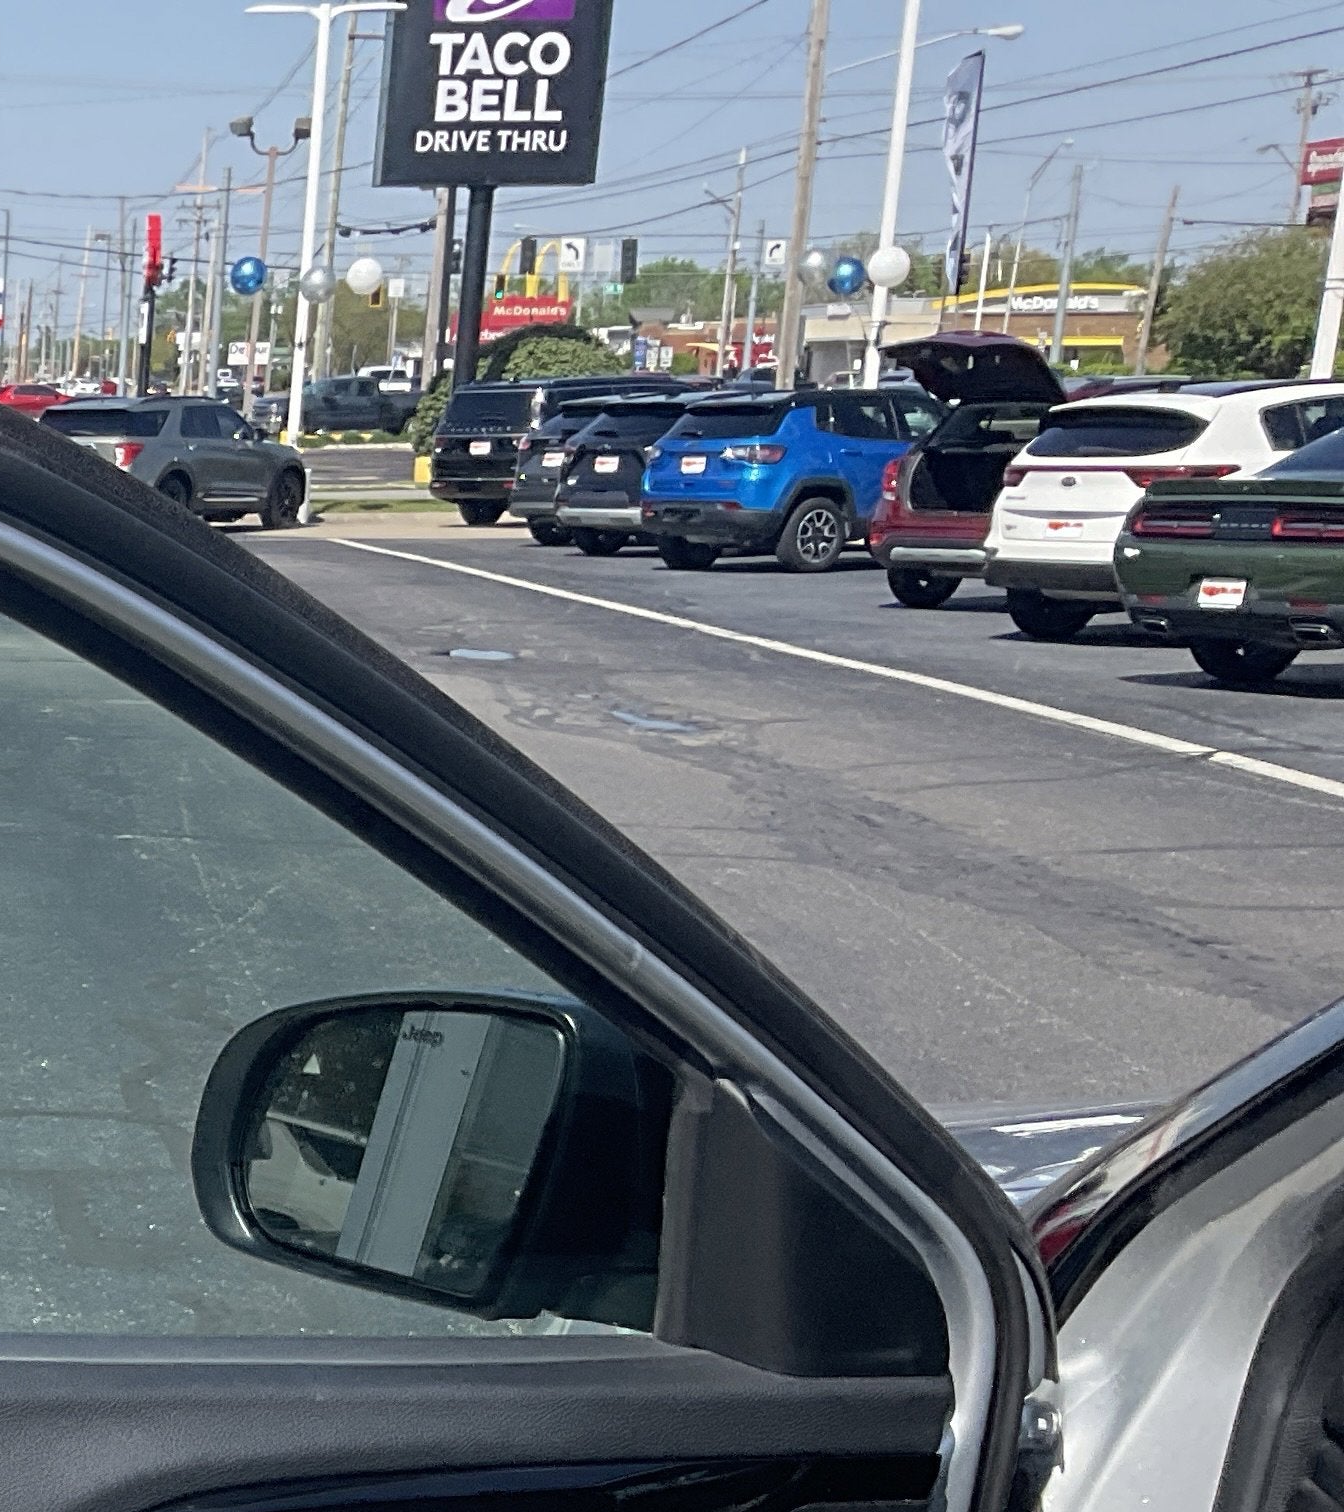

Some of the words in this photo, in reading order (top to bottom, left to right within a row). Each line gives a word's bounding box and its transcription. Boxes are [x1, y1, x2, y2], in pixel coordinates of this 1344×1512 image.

[429, 31, 571, 75] TACO
[434, 78, 563, 122] BELL
[415, 129, 492, 153] DRIVE
[497, 129, 568, 152] THRU
[493, 304, 567, 317] McDonald's
